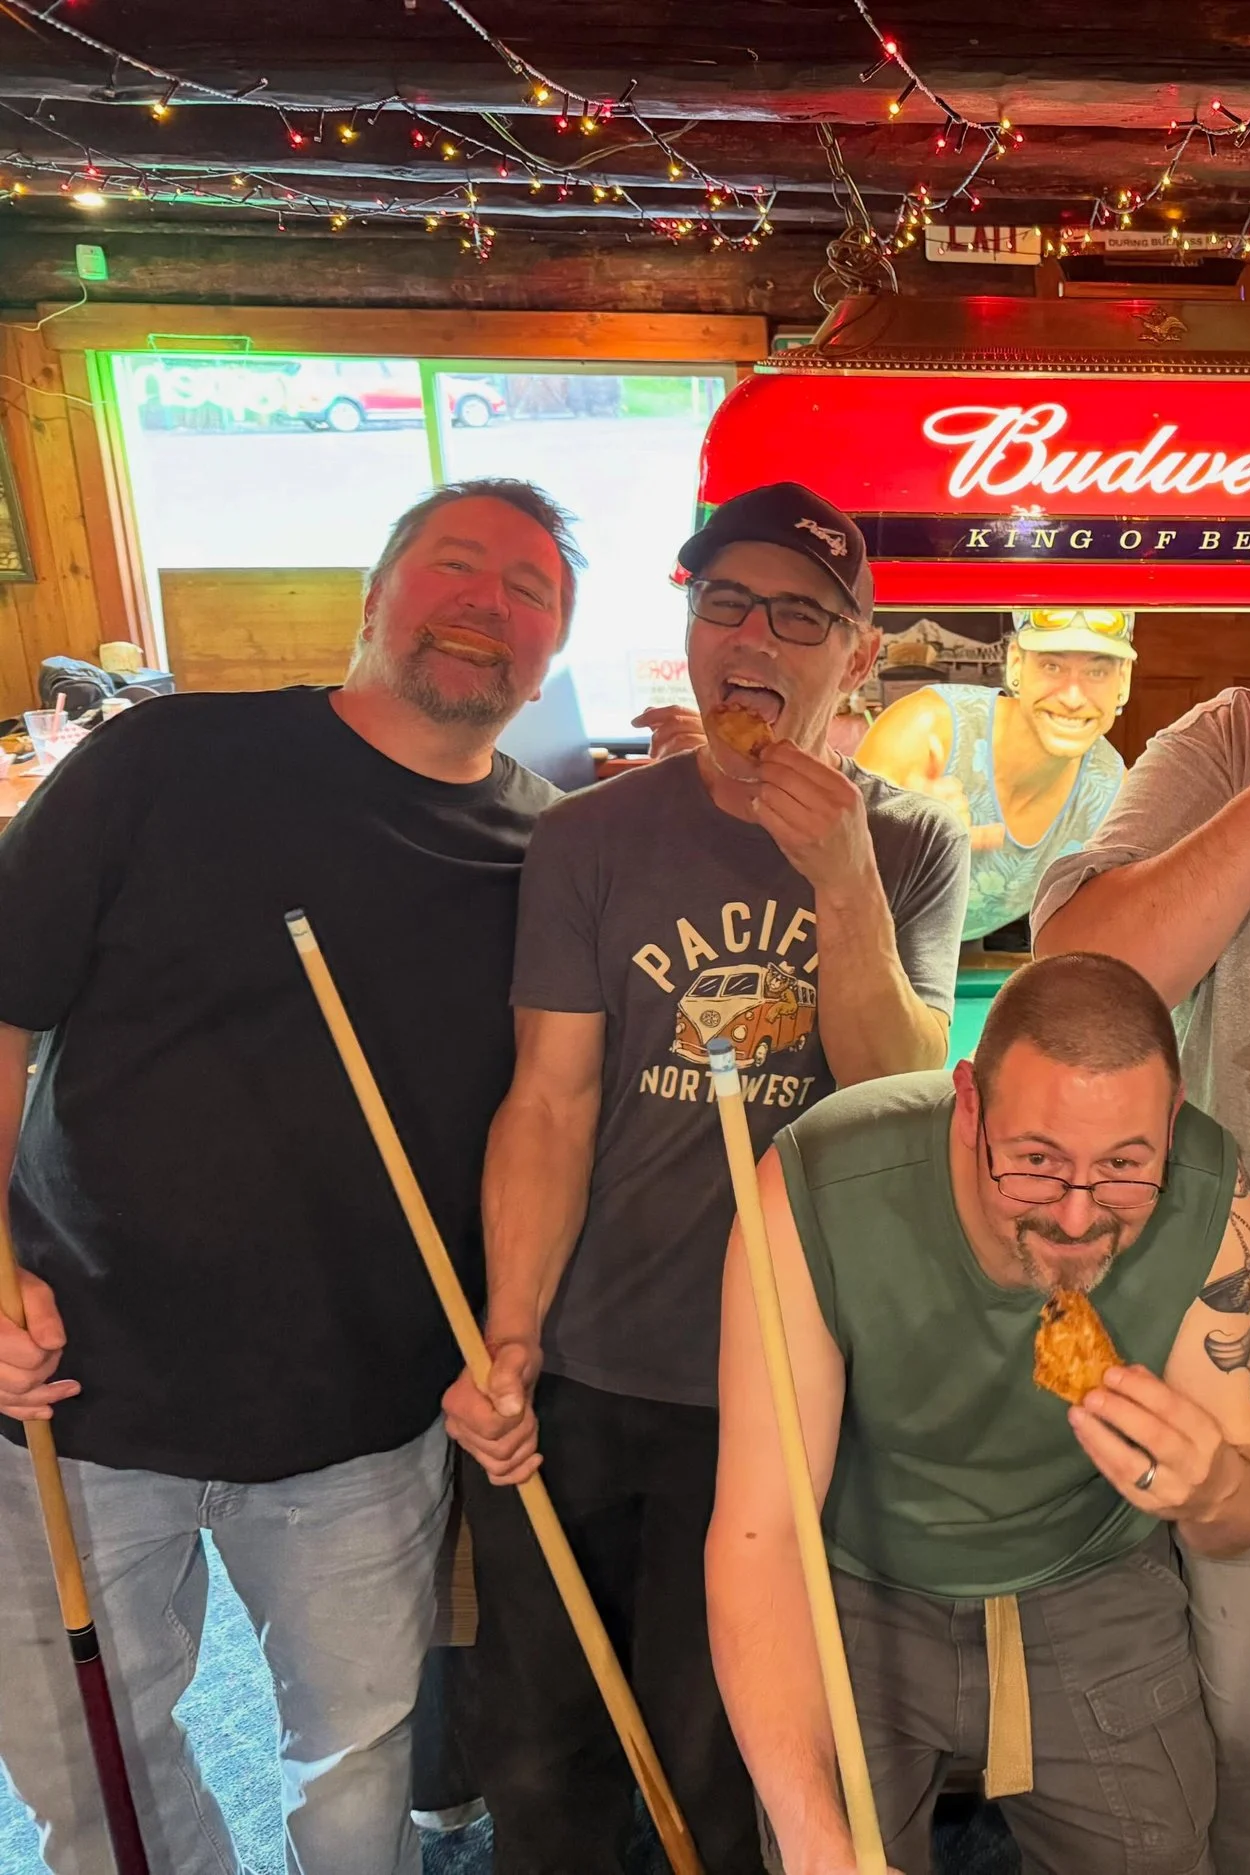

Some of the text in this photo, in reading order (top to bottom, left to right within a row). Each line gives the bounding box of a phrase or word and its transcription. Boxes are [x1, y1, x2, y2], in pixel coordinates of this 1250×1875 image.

[1108, 238, 1148, 248] DURING
[966, 528, 1094, 549] KING
[1119, 529, 1177, 549] OF
[632, 899, 818, 994] PACIF
[640, 1065, 816, 1108] NORTWEST
